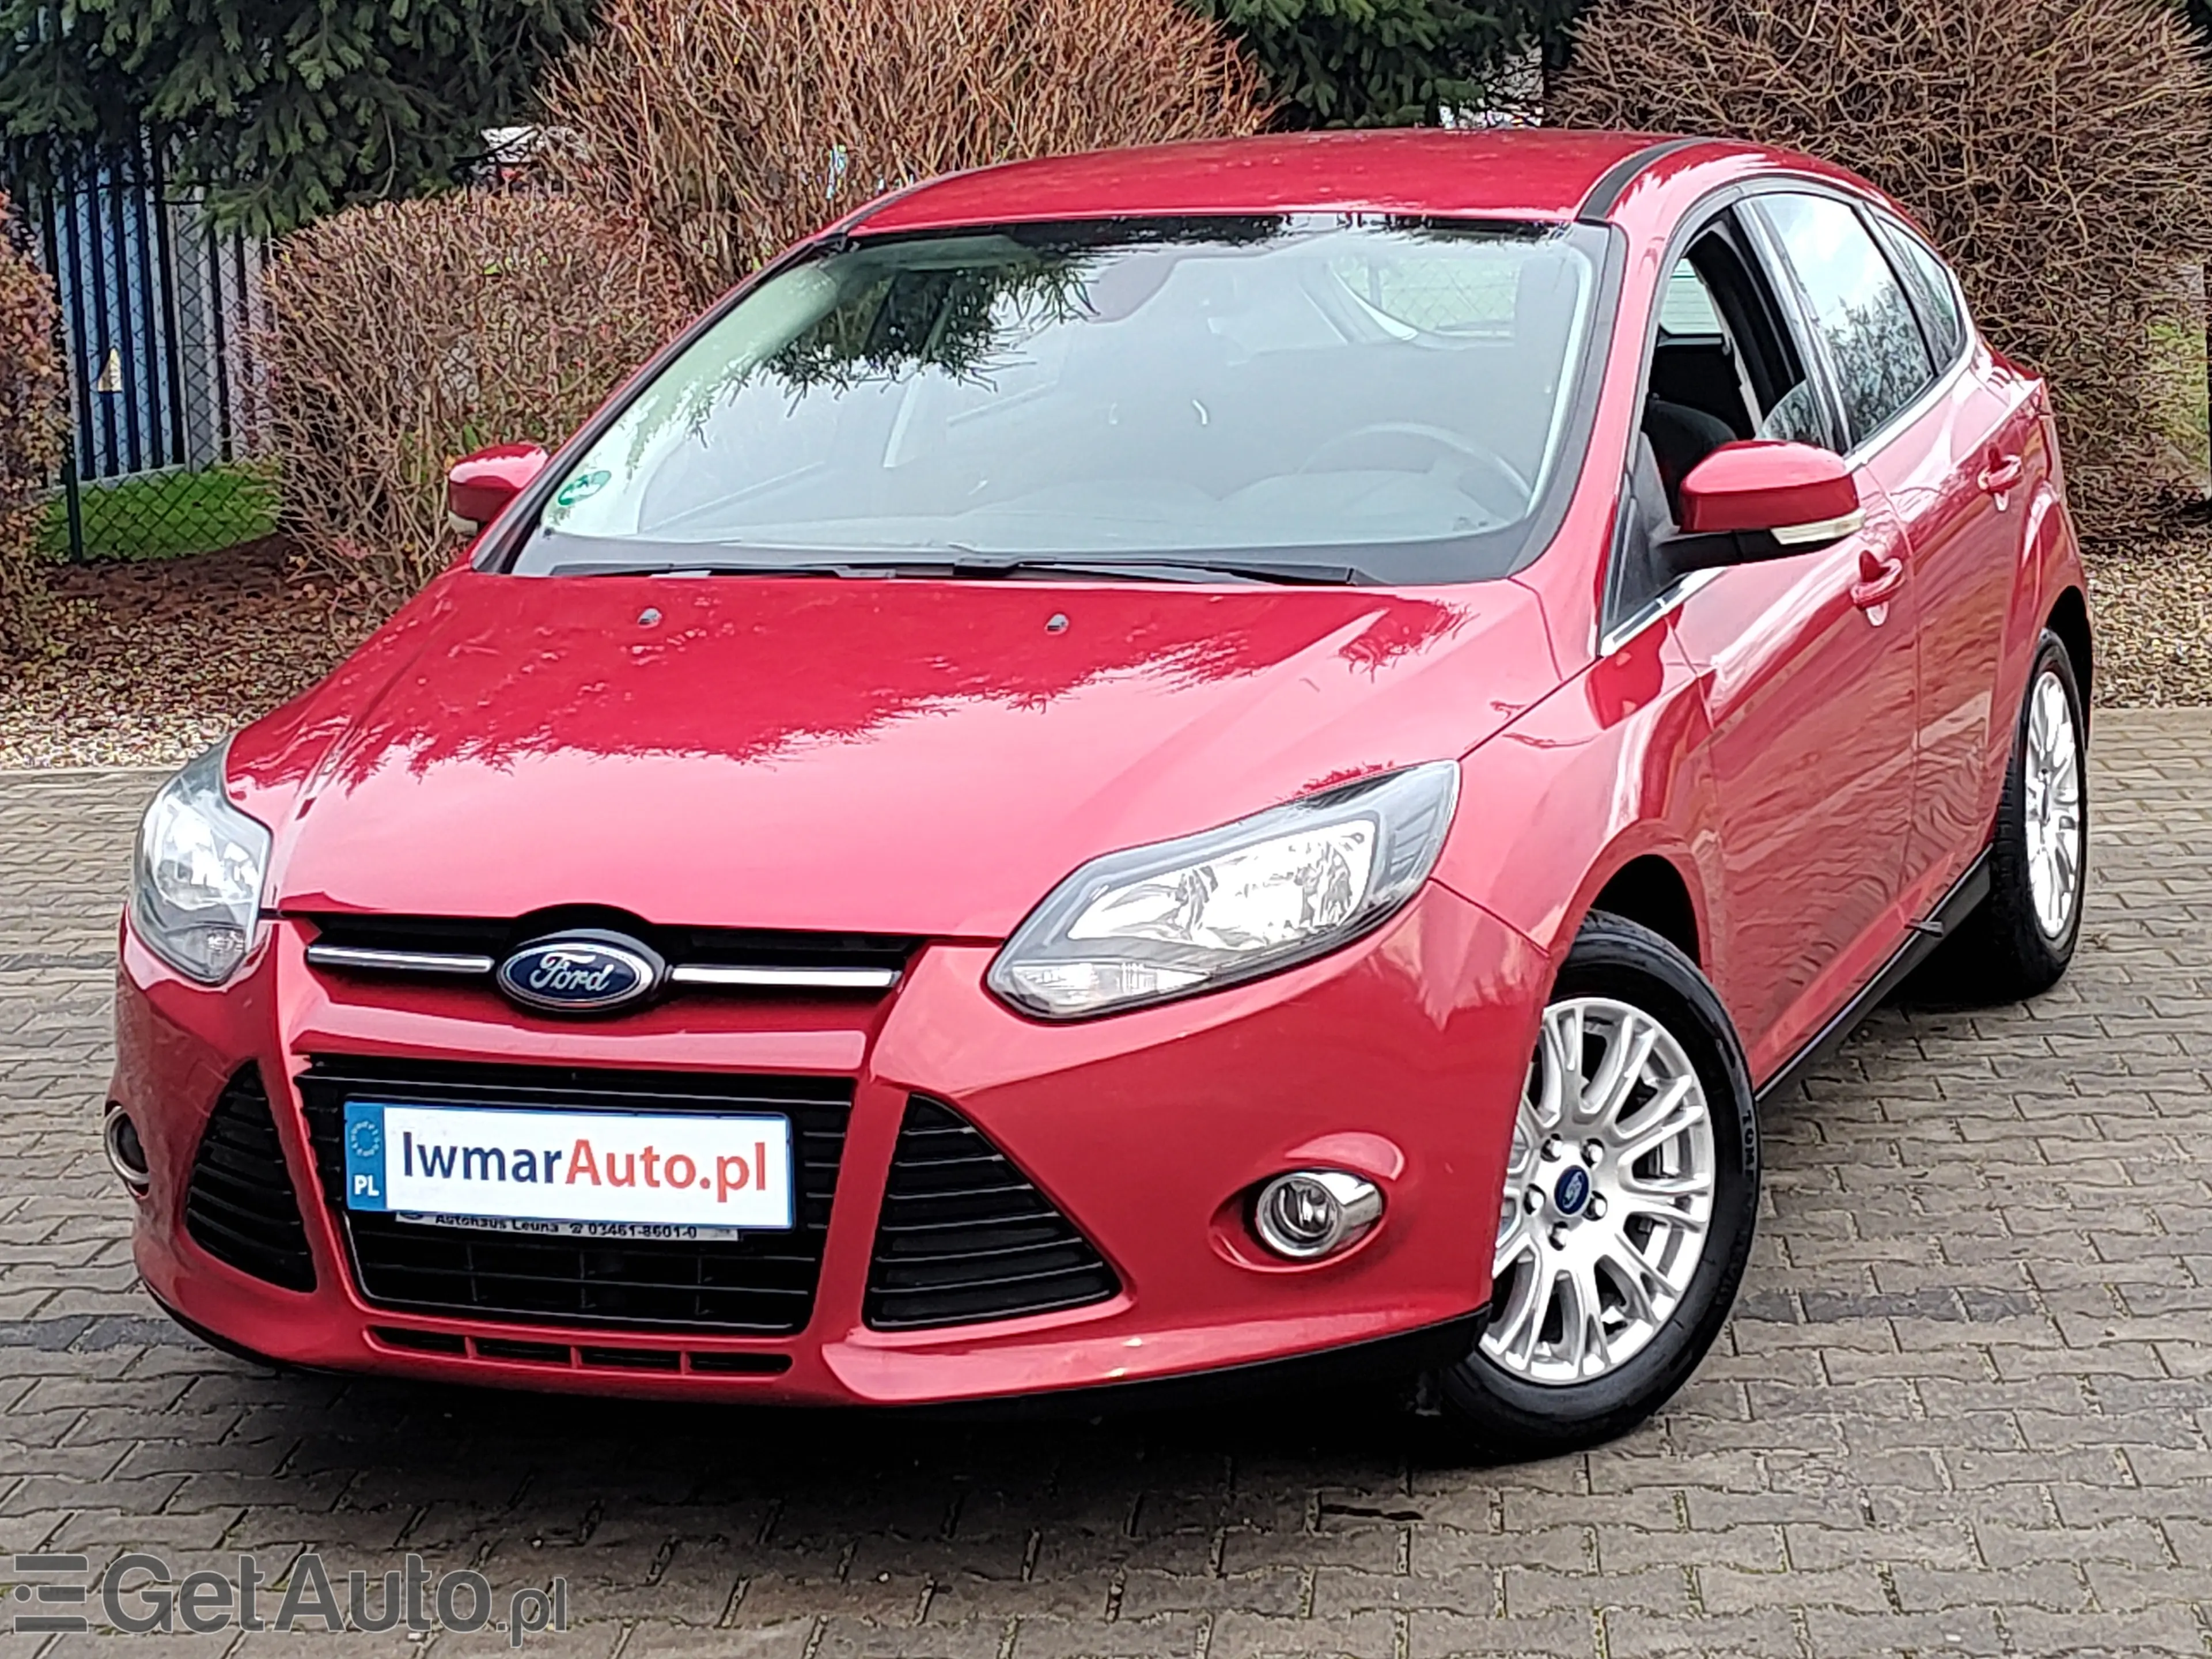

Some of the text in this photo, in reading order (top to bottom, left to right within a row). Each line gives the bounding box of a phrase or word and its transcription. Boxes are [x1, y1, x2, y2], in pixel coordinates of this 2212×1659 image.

[529, 952, 614, 991] Ford
[403, 1131, 766, 1203] IwmarAuto.pl
[354, 1175, 380, 1196] PL
[435, 1214, 506, 1229] Autohaus
[512, 1218, 558, 1232] Leuna
